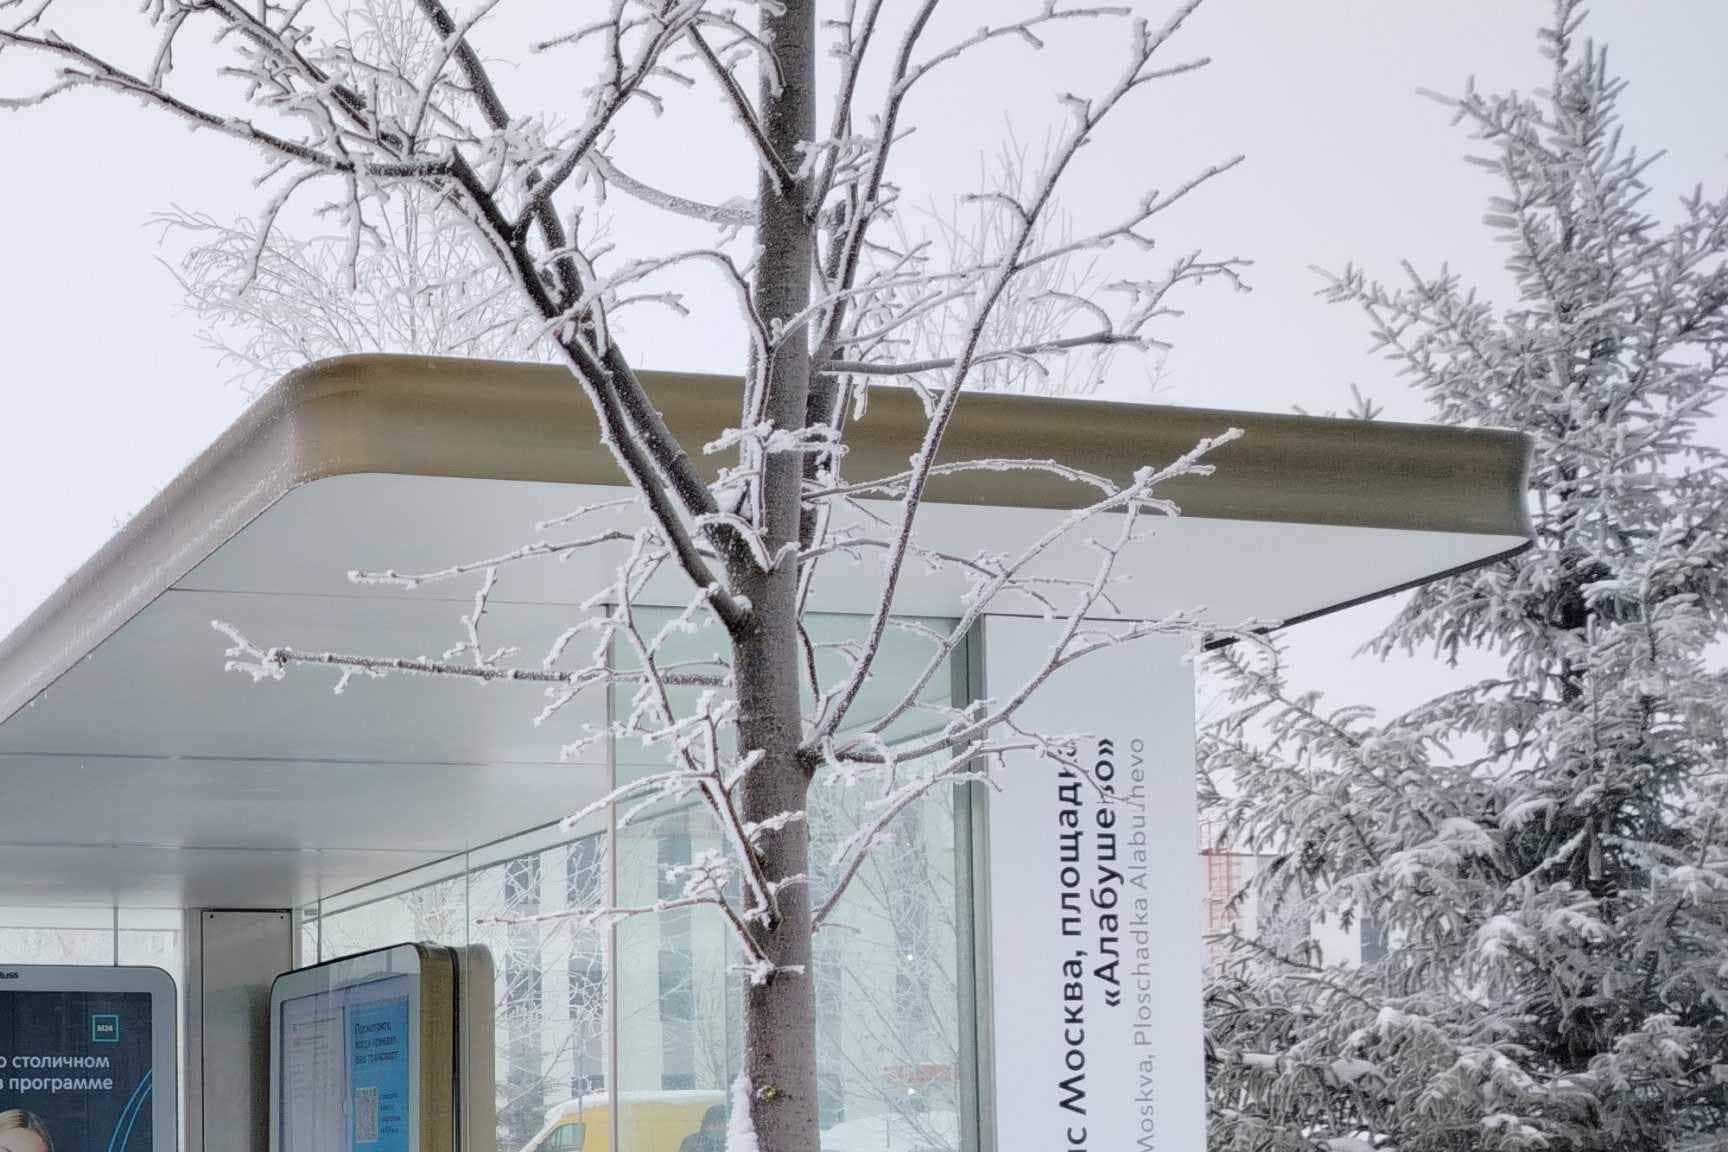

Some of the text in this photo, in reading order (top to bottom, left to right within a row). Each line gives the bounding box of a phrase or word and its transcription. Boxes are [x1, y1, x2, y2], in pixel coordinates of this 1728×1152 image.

[1129, 898, 1153, 1046] Ploschadka
[12, 1055, 110, 1069] столичном
[1058, 950, 1088, 1116] Москва,
[9, 1077, 113, 1093] программе
